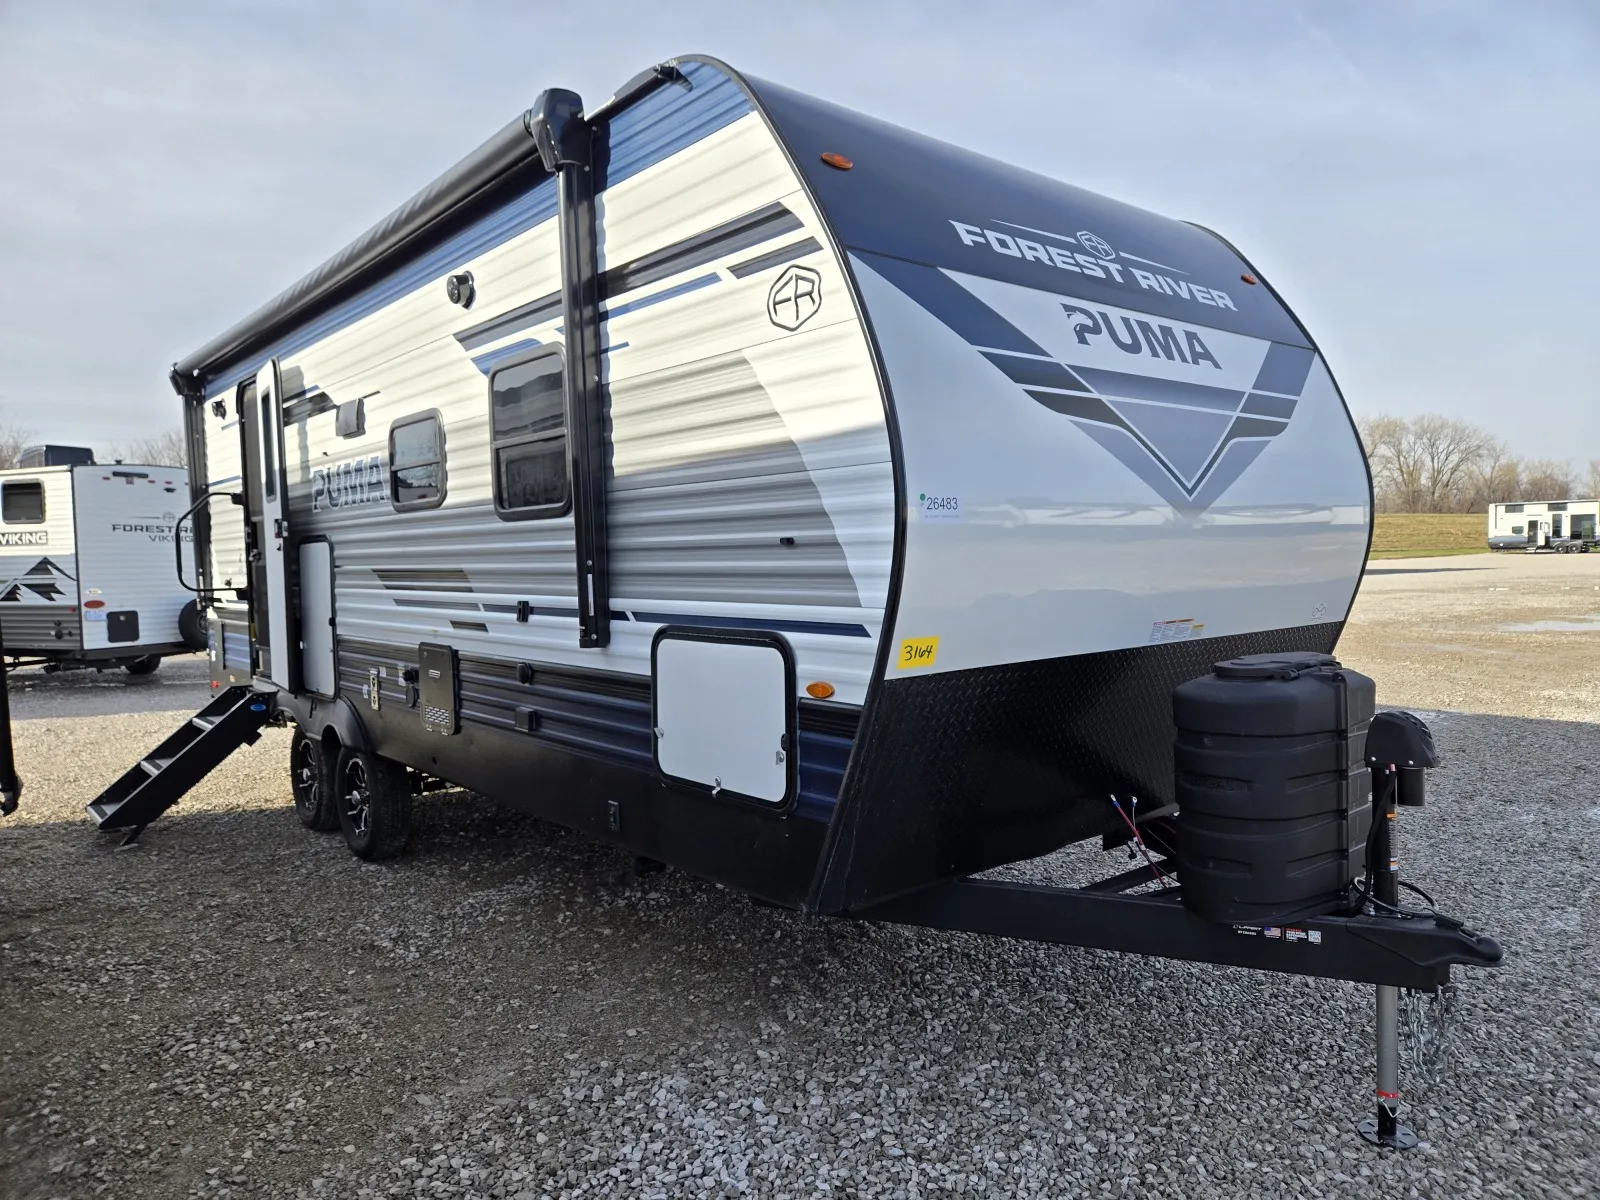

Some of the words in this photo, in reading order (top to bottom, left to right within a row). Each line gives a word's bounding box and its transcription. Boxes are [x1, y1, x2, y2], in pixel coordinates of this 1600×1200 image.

[948, 220, 1125, 283] FOREST
[1129, 268, 1239, 312] RIVER
[1059, 303, 1223, 370] PUMA
[312, 453, 388, 513] PUMA
[926, 496, 959, 510] 26483
[111, 524, 175, 533] FOREST
[0, 532, 47, 545] VIKING
[904, 644, 933, 661] 3164
